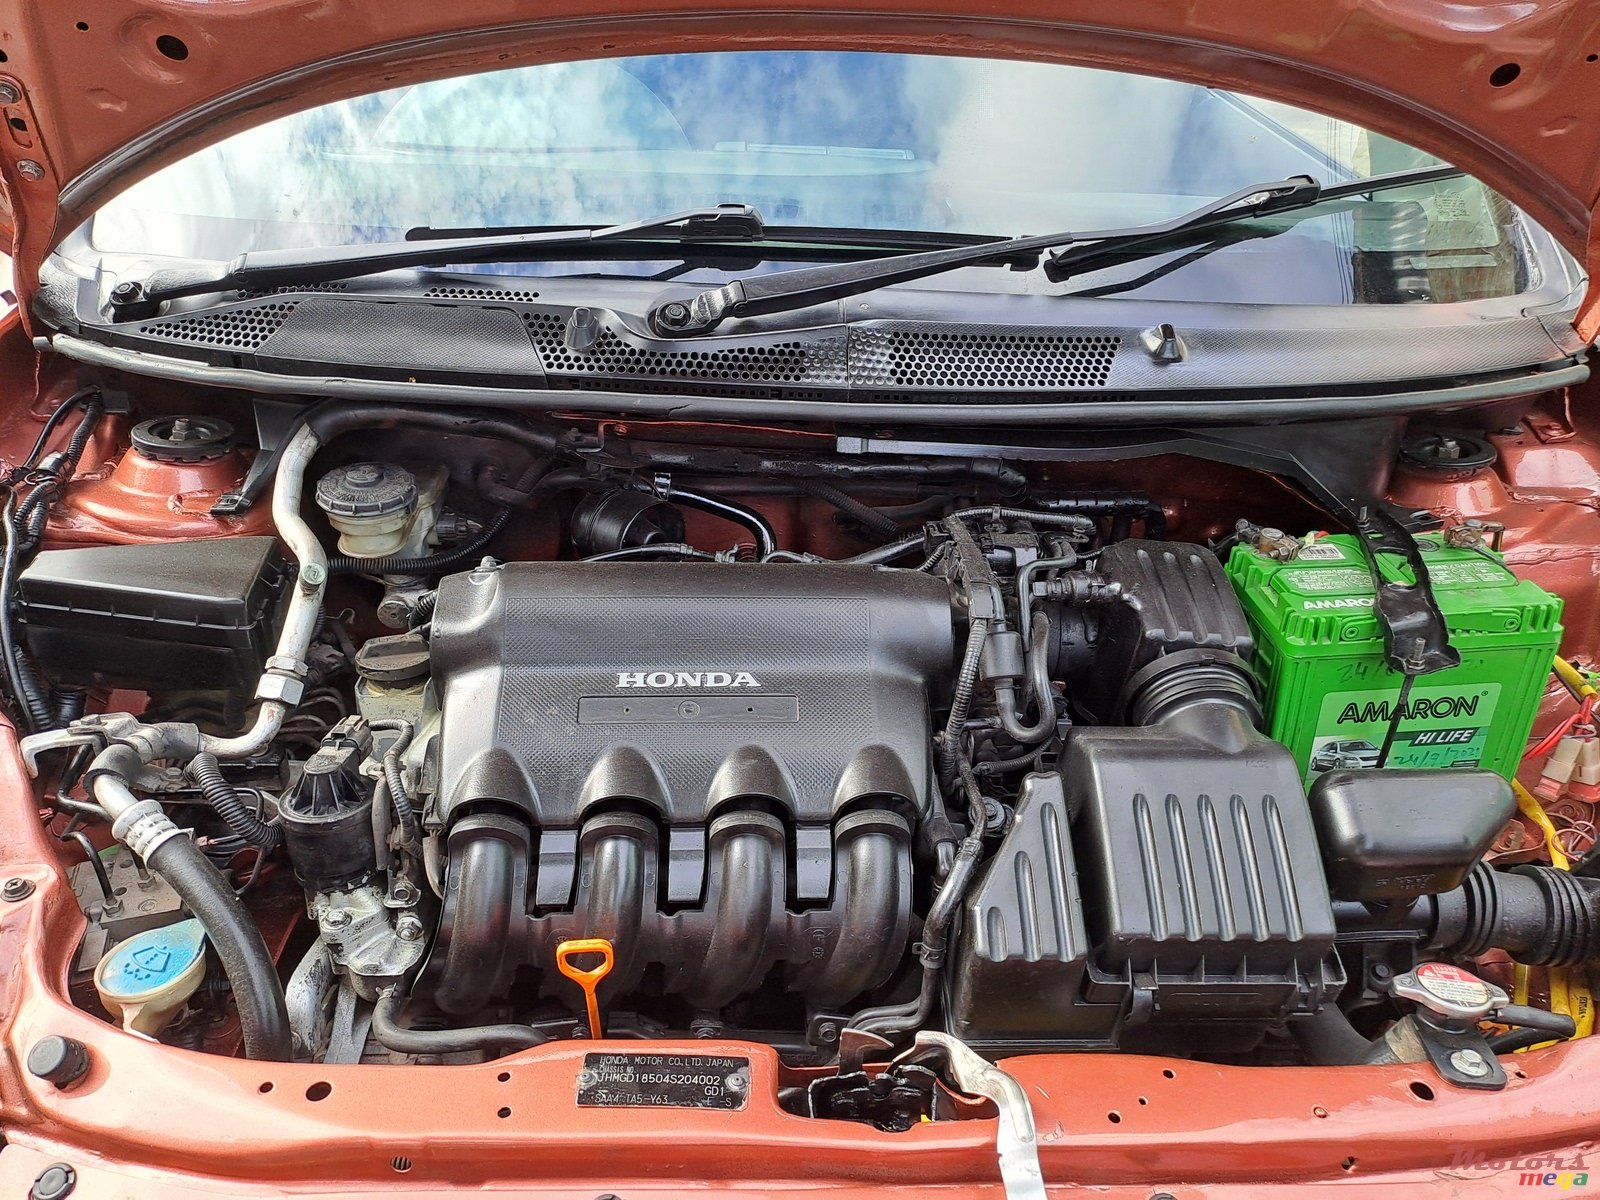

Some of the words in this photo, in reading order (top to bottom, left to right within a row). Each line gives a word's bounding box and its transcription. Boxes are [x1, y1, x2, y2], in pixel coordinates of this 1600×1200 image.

[1303, 598, 1375, 610] AMARO
[616, 672, 761, 688] HONDA
[1337, 695, 1479, 724] AMARON
[1414, 732, 1435, 745] HI
[1436, 729, 1474, 743] LIFE
[600, 1056, 629, 1066] HONDA
[634, 1056, 664, 1066] MOTOR
[705, 1059, 734, 1068] JAPAN
[598, 1073, 721, 1086] JHMGD18504S204002
[704, 1086, 724, 1097] GD1
